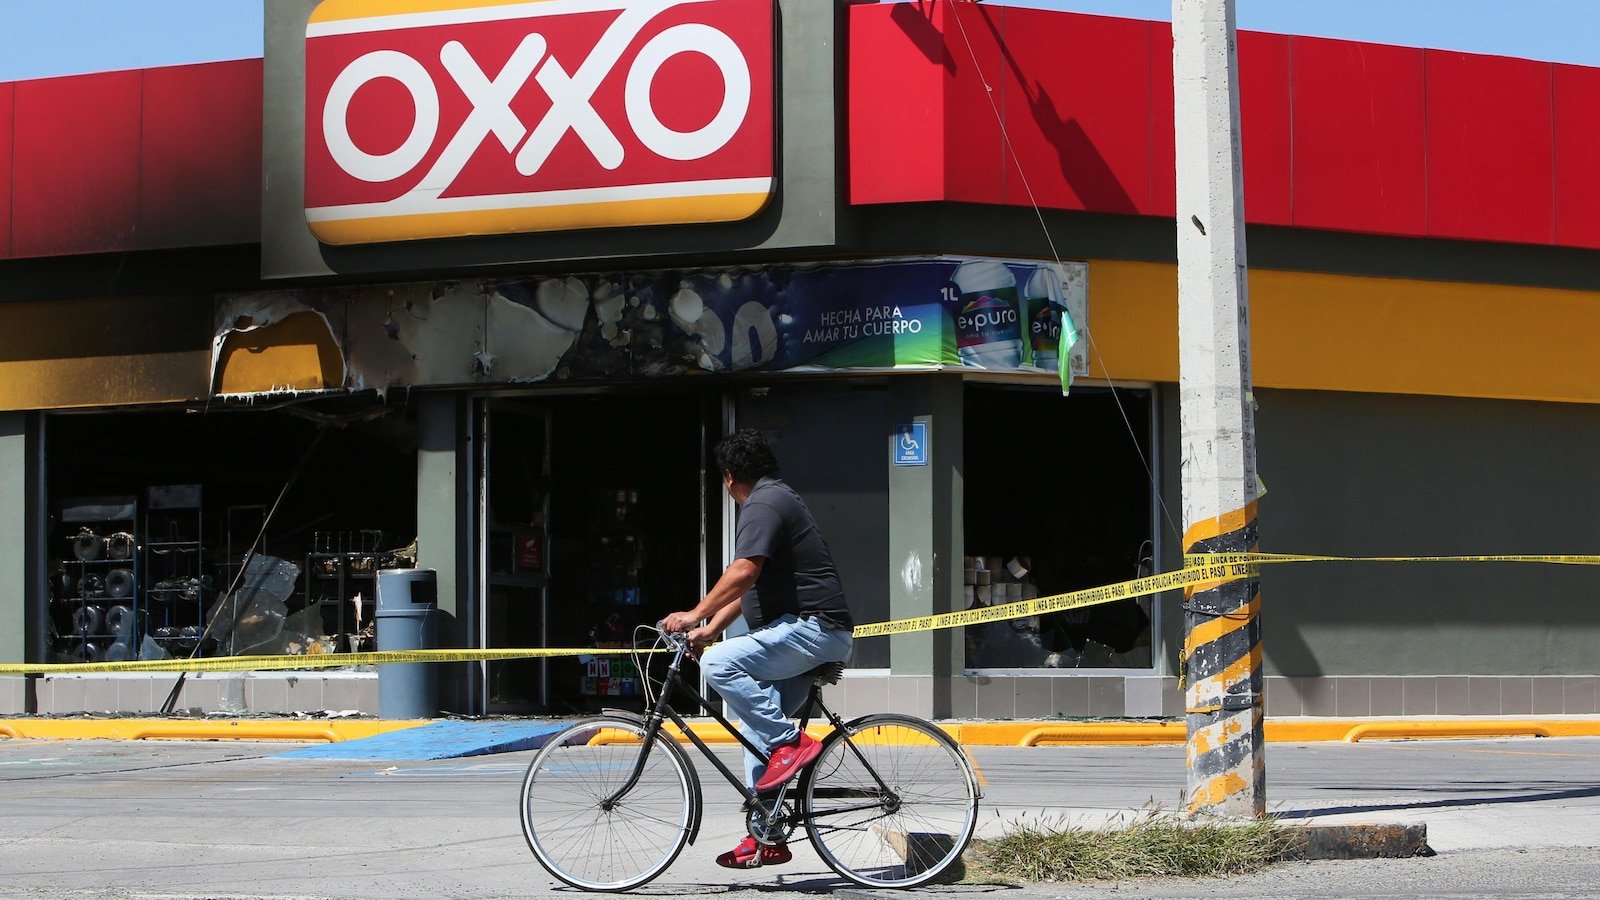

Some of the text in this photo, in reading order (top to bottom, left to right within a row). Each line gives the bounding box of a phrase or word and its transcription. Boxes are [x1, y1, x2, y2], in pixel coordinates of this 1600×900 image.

[322, 20, 752, 184] OXXO
[941, 287, 959, 301] 1L
[821, 305, 903, 326] HECHA PARA
[803, 328, 840, 343] AMAR
[863, 319, 922, 336] CUERPO
[1194, 557, 1204, 566] ASO
[1210, 556, 1228, 564] LINEA
[862, 626, 882, 635] POLICIA
[882, 621, 911, 633] PROHIBIDO
[912, 620, 918, 630] EL
[918, 618, 932, 628] PASO
[936, 616, 950, 626] LINEA
[952, 614, 959, 624] DE
[960, 612, 980, 624] POLICIA
[980, 606, 1008, 622] PROHIBIDO
[1009, 606, 1014, 616] EL
[1016, 602, 1028, 615] PASO
[1034, 600, 1048, 612] LINEA
[1048, 598, 1056, 610] DE
[1056, 595, 1076, 608] POLICIA
[1077, 590, 1104, 604] PROHIBIDO
[1104, 588, 1111, 599] EL
[1112, 585, 1124, 597] PASO
[1130, 582, 1144, 594] LINEA
[1144, 580, 1152, 591] DE
[1152, 576, 1172, 589] POLICIA
[1172, 569, 1200, 586] PROHIBIDO
[1202, 568, 1209, 580] EL
[1210, 566, 1226, 578] PASO
